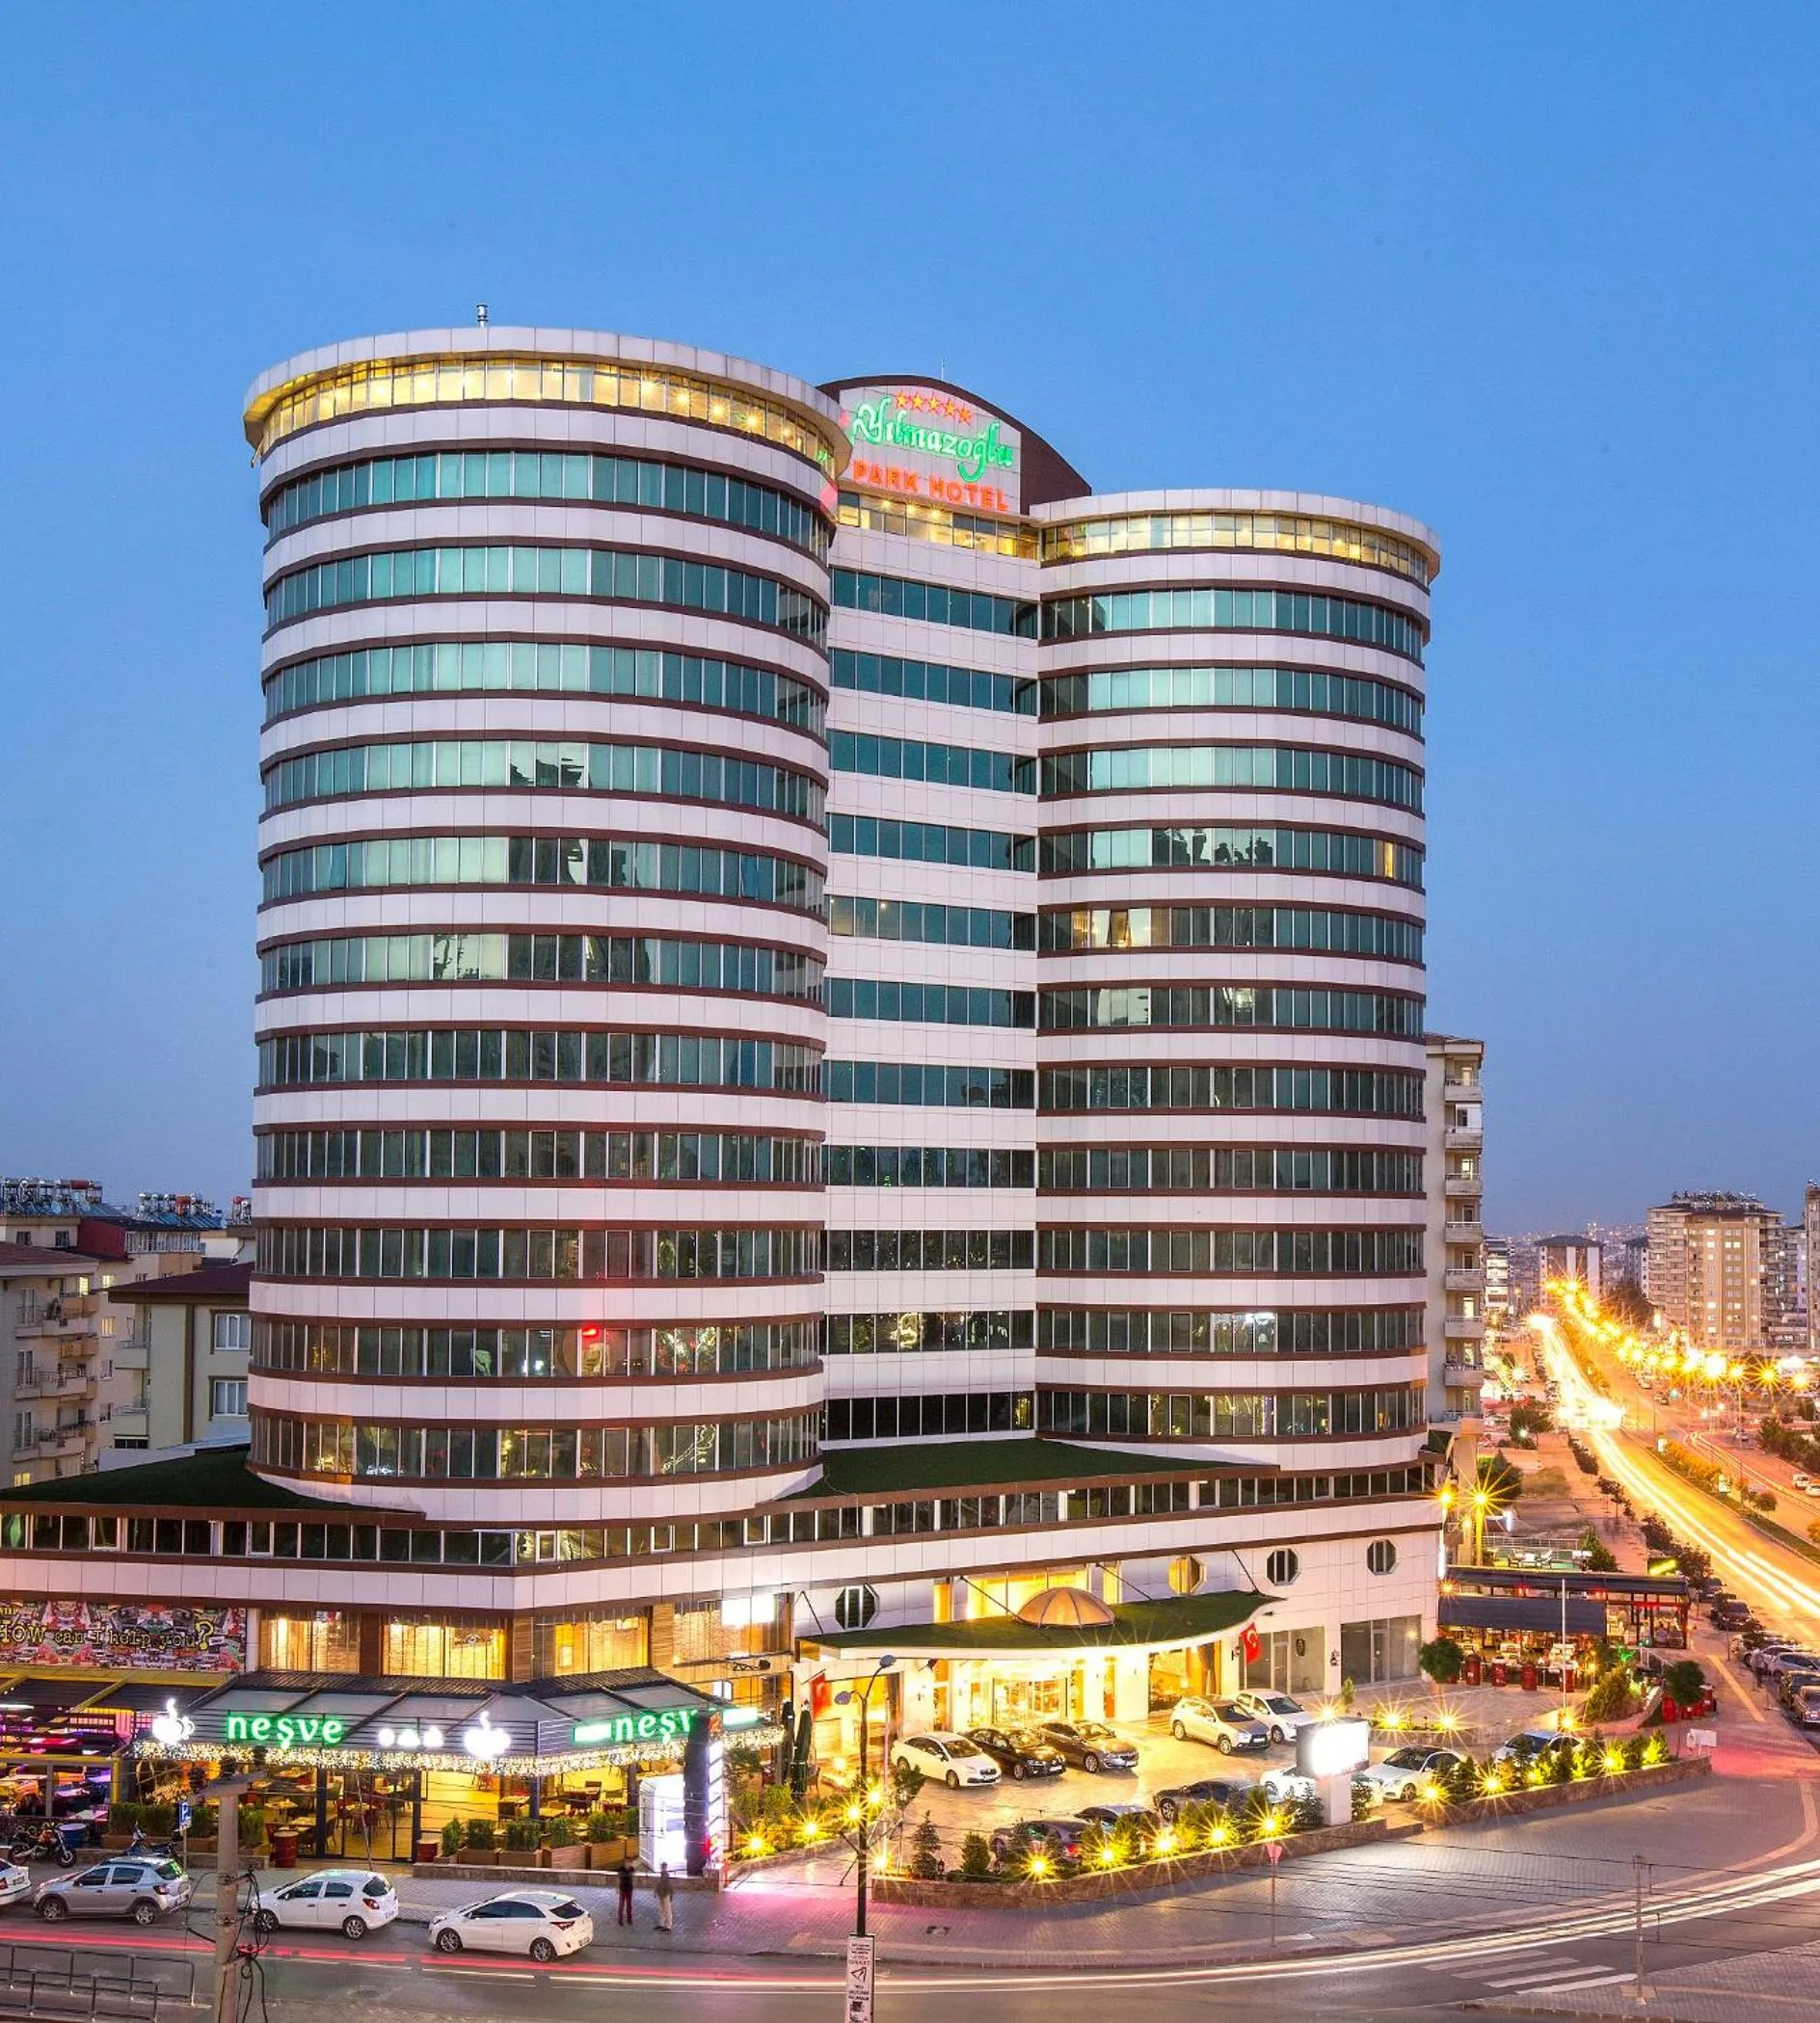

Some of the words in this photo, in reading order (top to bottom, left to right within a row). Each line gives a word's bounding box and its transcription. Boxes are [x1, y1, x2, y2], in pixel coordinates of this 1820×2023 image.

[853, 459, 919, 492] PARK
[928, 477, 1009, 512] HOTEL
[54, 1631, 84, 1643] can
[108, 1630, 150, 1648] help
